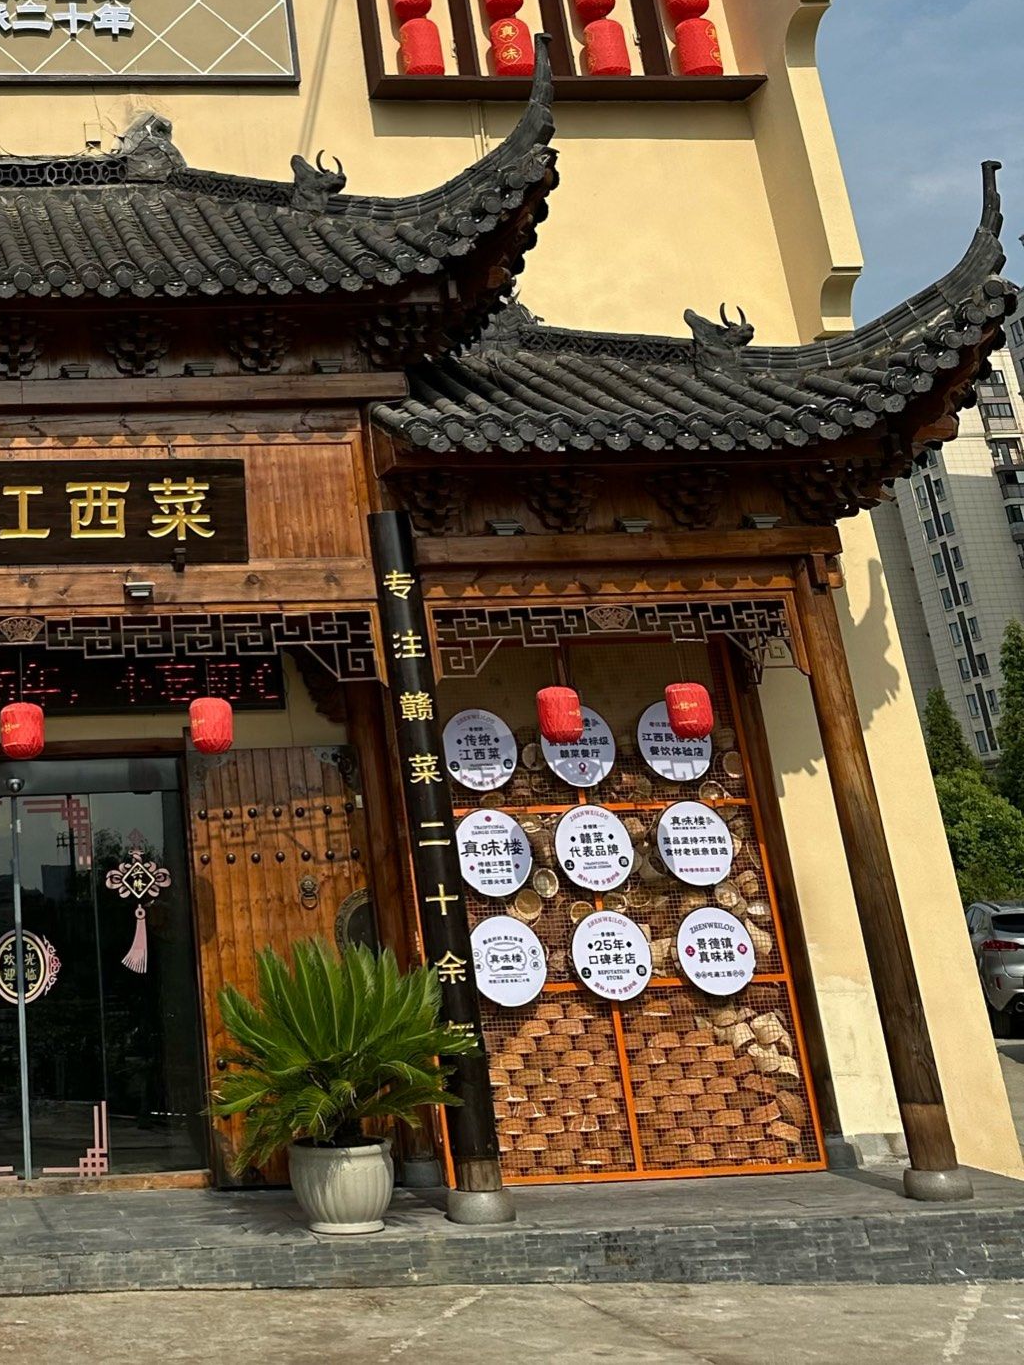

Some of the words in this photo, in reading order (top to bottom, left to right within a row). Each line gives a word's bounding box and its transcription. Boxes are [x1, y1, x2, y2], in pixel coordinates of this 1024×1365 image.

[464, 734, 492, 746] 传统
[459, 748, 501, 760] 江西菜
[650, 746, 704, 756] 餐饮体验店
[670, 815, 705, 826] 真味楼
[579, 832, 604, 843] 赣菜
[461, 838, 524, 857] 真味楼
[569, 844, 619, 858] 代表品牌
[689, 922, 735, 934] ZHENWEILOU
[594, 939, 625, 951] 25年
[696, 937, 733, 950] 景德镇
[588, 952, 636, 965] 口碑老店
[699, 950, 735, 963] 真味楼
